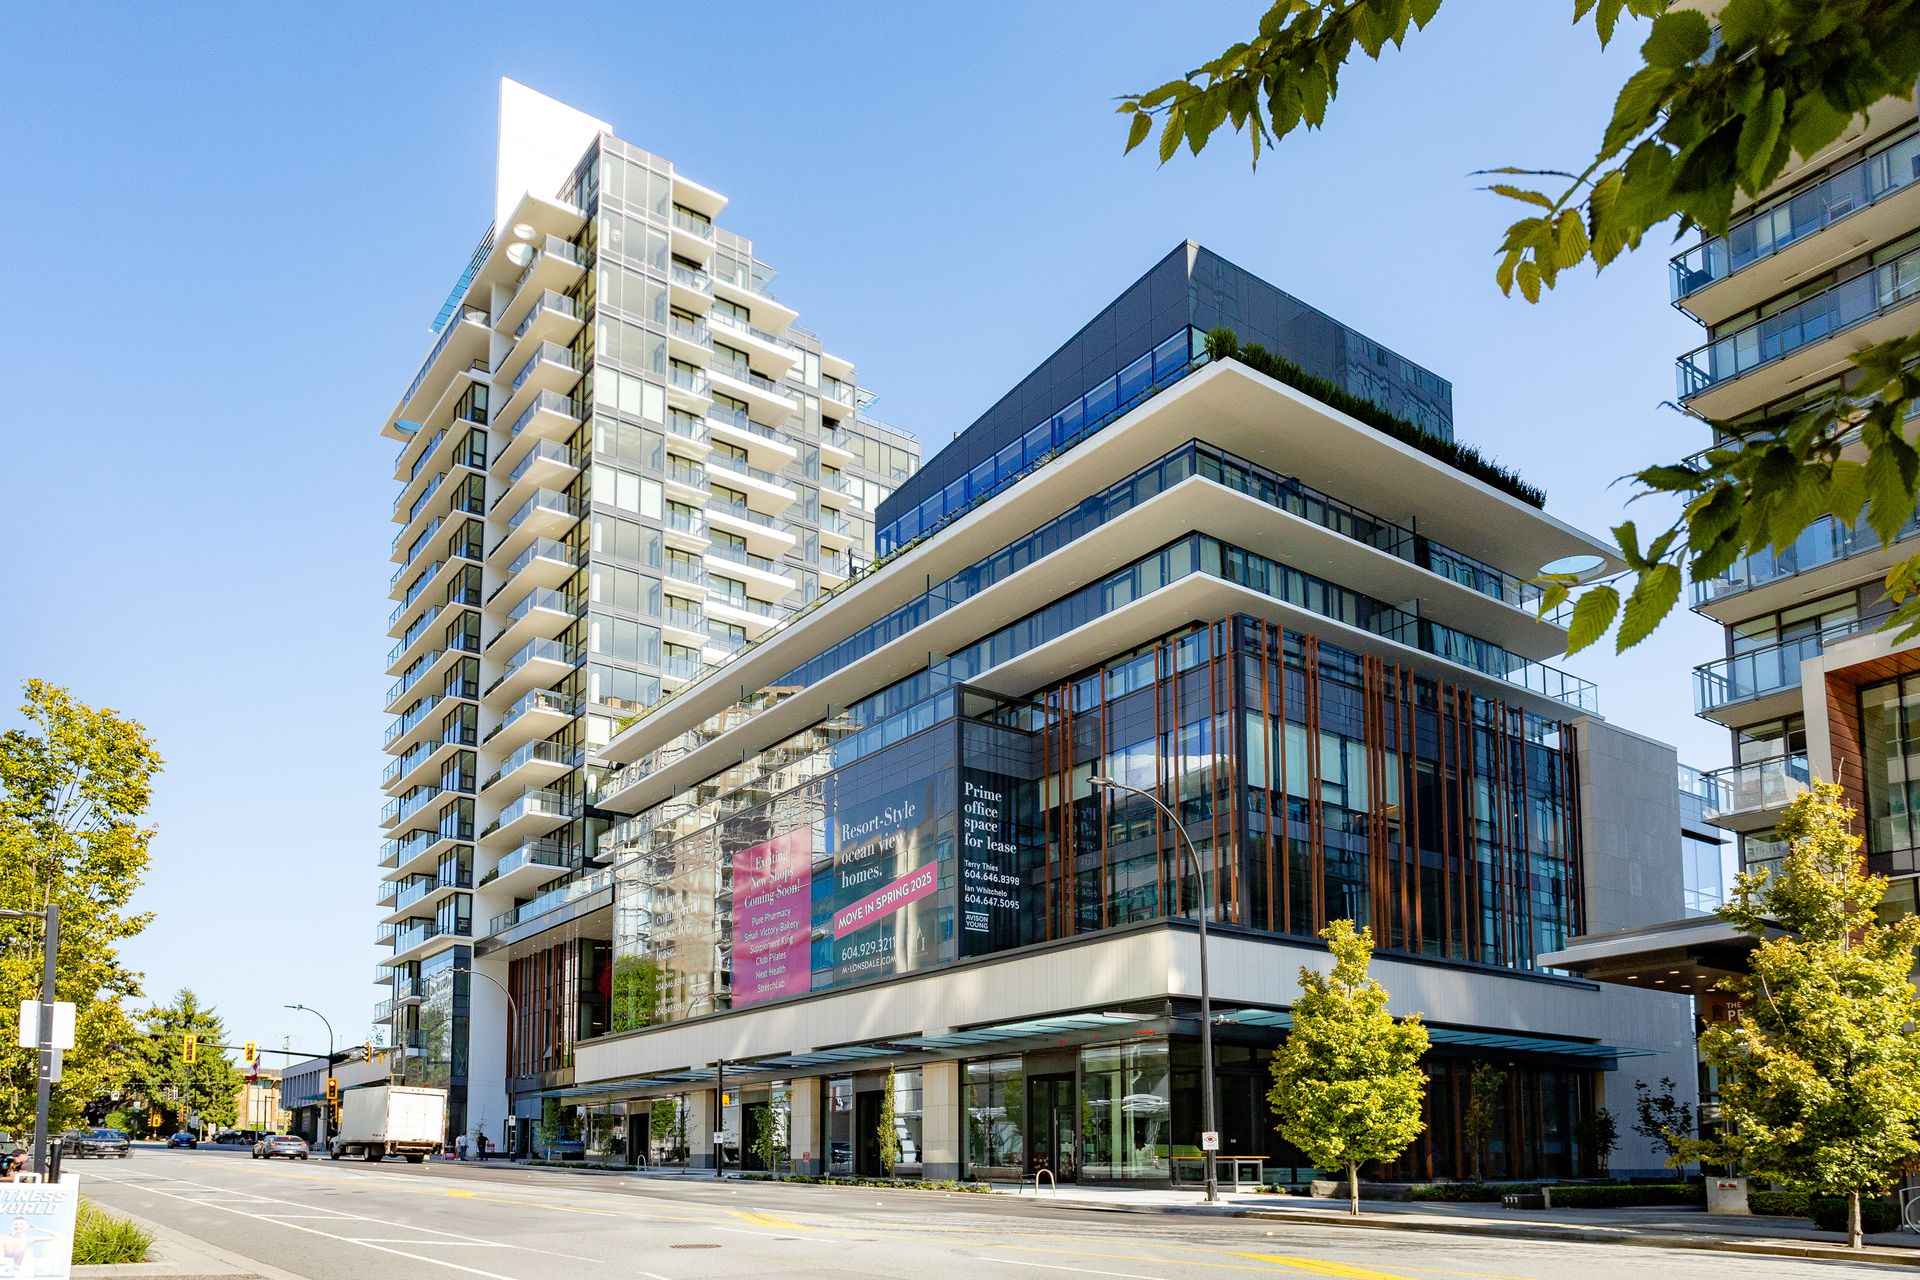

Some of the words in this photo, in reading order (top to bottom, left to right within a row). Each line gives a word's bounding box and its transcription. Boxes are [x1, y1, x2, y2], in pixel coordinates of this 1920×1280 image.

[964, 782, 1002, 802] Prime
[964, 801, 998, 818] office
[842, 801, 916, 842] Resort-Style
[964, 818, 998, 833] space
[841, 841, 876, 865] ocean
[878, 832, 906, 857] view
[964, 832, 984, 848] for
[987, 836, 1017, 854] lease
[755, 849, 789, 870] Exciting
[964, 860, 980, 870] Terry
[982, 862, 999, 872] Thies
[751, 876, 766, 889] New
[769, 868, 794, 885] Shops
[841, 865, 883, 889] homes.
[964, 869, 1020, 886] 604.646.8398
[744, 890, 775, 909] Coming
[776, 878, 801, 899] Soon!
[964, 884, 975, 892] Ian
[838, 907, 864, 930] MOVE
[865, 901, 875, 916] IN
[876, 883, 909, 910] SPRING
[911, 871, 932, 893] 2025
[964, 894, 1020, 910] 604.647.5095
[752, 916, 764, 927] Pure
[764, 908, 791, 922] Pharmacy
[966, 914, 988, 923] AVISON
[966, 920, 988, 929] YOUNG
[744, 930, 759, 942] Small
[760, 926, 779, 937] Victory
[780, 919, 800, 932] Bakery
[750, 938, 780, 954] Supplement
[781, 934, 794, 947] King
[842, 936, 896, 960] 604.929.3211
[755, 955, 768, 966] Club
[769, 951, 787, 962] Pilates
[755, 970, 768, 980] Next
[768, 964, 787, 976] Health
[757, 980, 786, 993] StretchLab
[1726, 1001, 1742, 1009] THE
[0, 1189, 66, 1202] ITNESS
